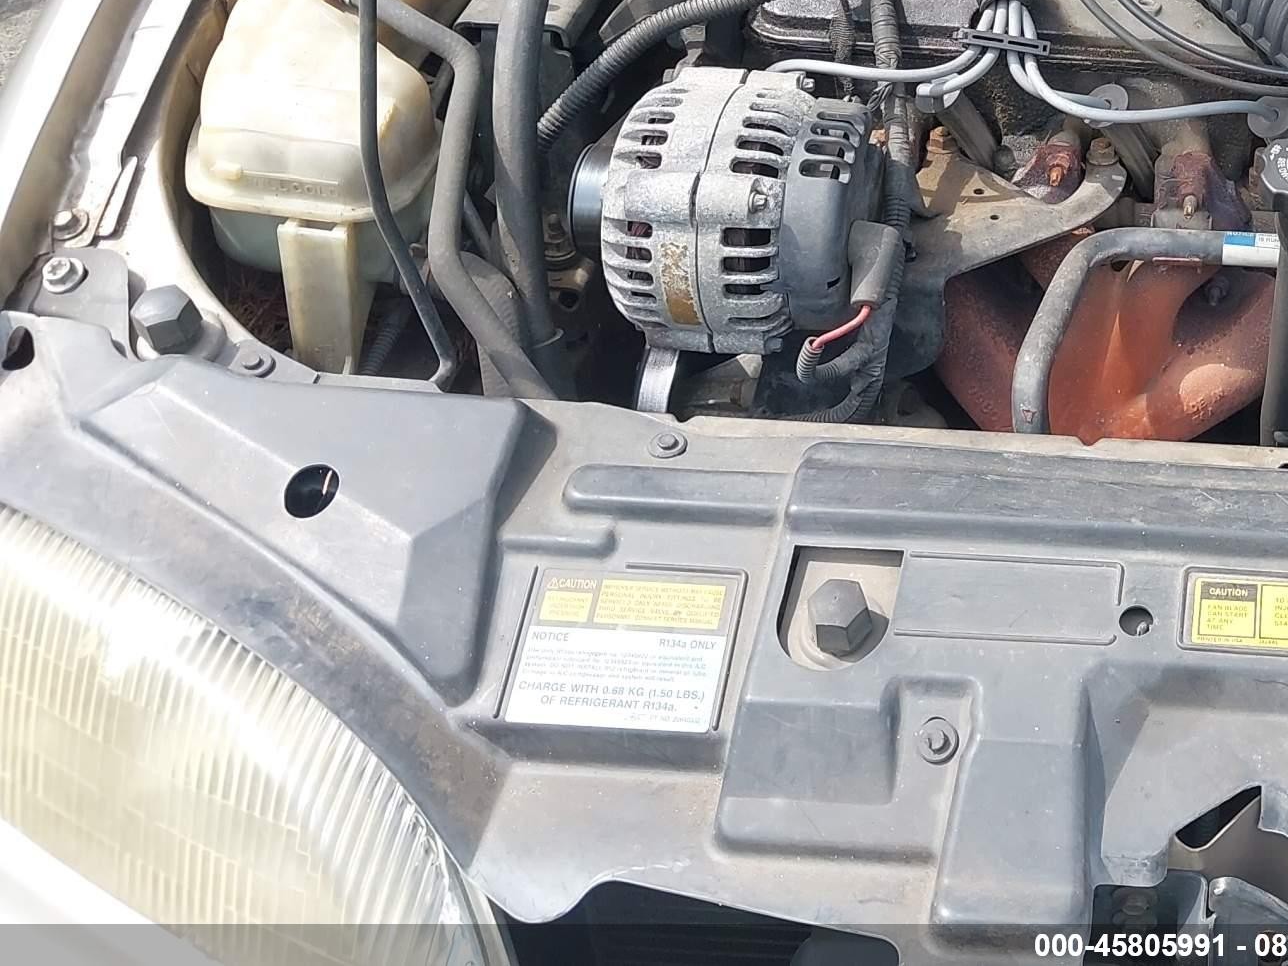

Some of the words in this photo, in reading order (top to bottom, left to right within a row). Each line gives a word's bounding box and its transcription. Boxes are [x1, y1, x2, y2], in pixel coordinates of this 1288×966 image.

[1277, 157, 1286, 168] SEE
[560, 578, 597, 590] CAUTION
[1209, 587, 1248, 598] CAUTION
[532, 632, 569, 642] NOTICE
[659, 638, 687, 649] R134a
[690, 640, 717, 650] ONLY
[519, 681, 566, 692] CHARGE
[570, 684, 598, 694] WITH
[602, 686, 624, 695] 0.68
[628, 687, 644, 696] KG
[648, 688, 673, 699] (1.50
[676, 690, 705, 703] LBS.)
[541, 695, 557, 705] OF
[560, 696, 640, 710] REFRIGERANT
[643, 701, 677, 712] R134a.
